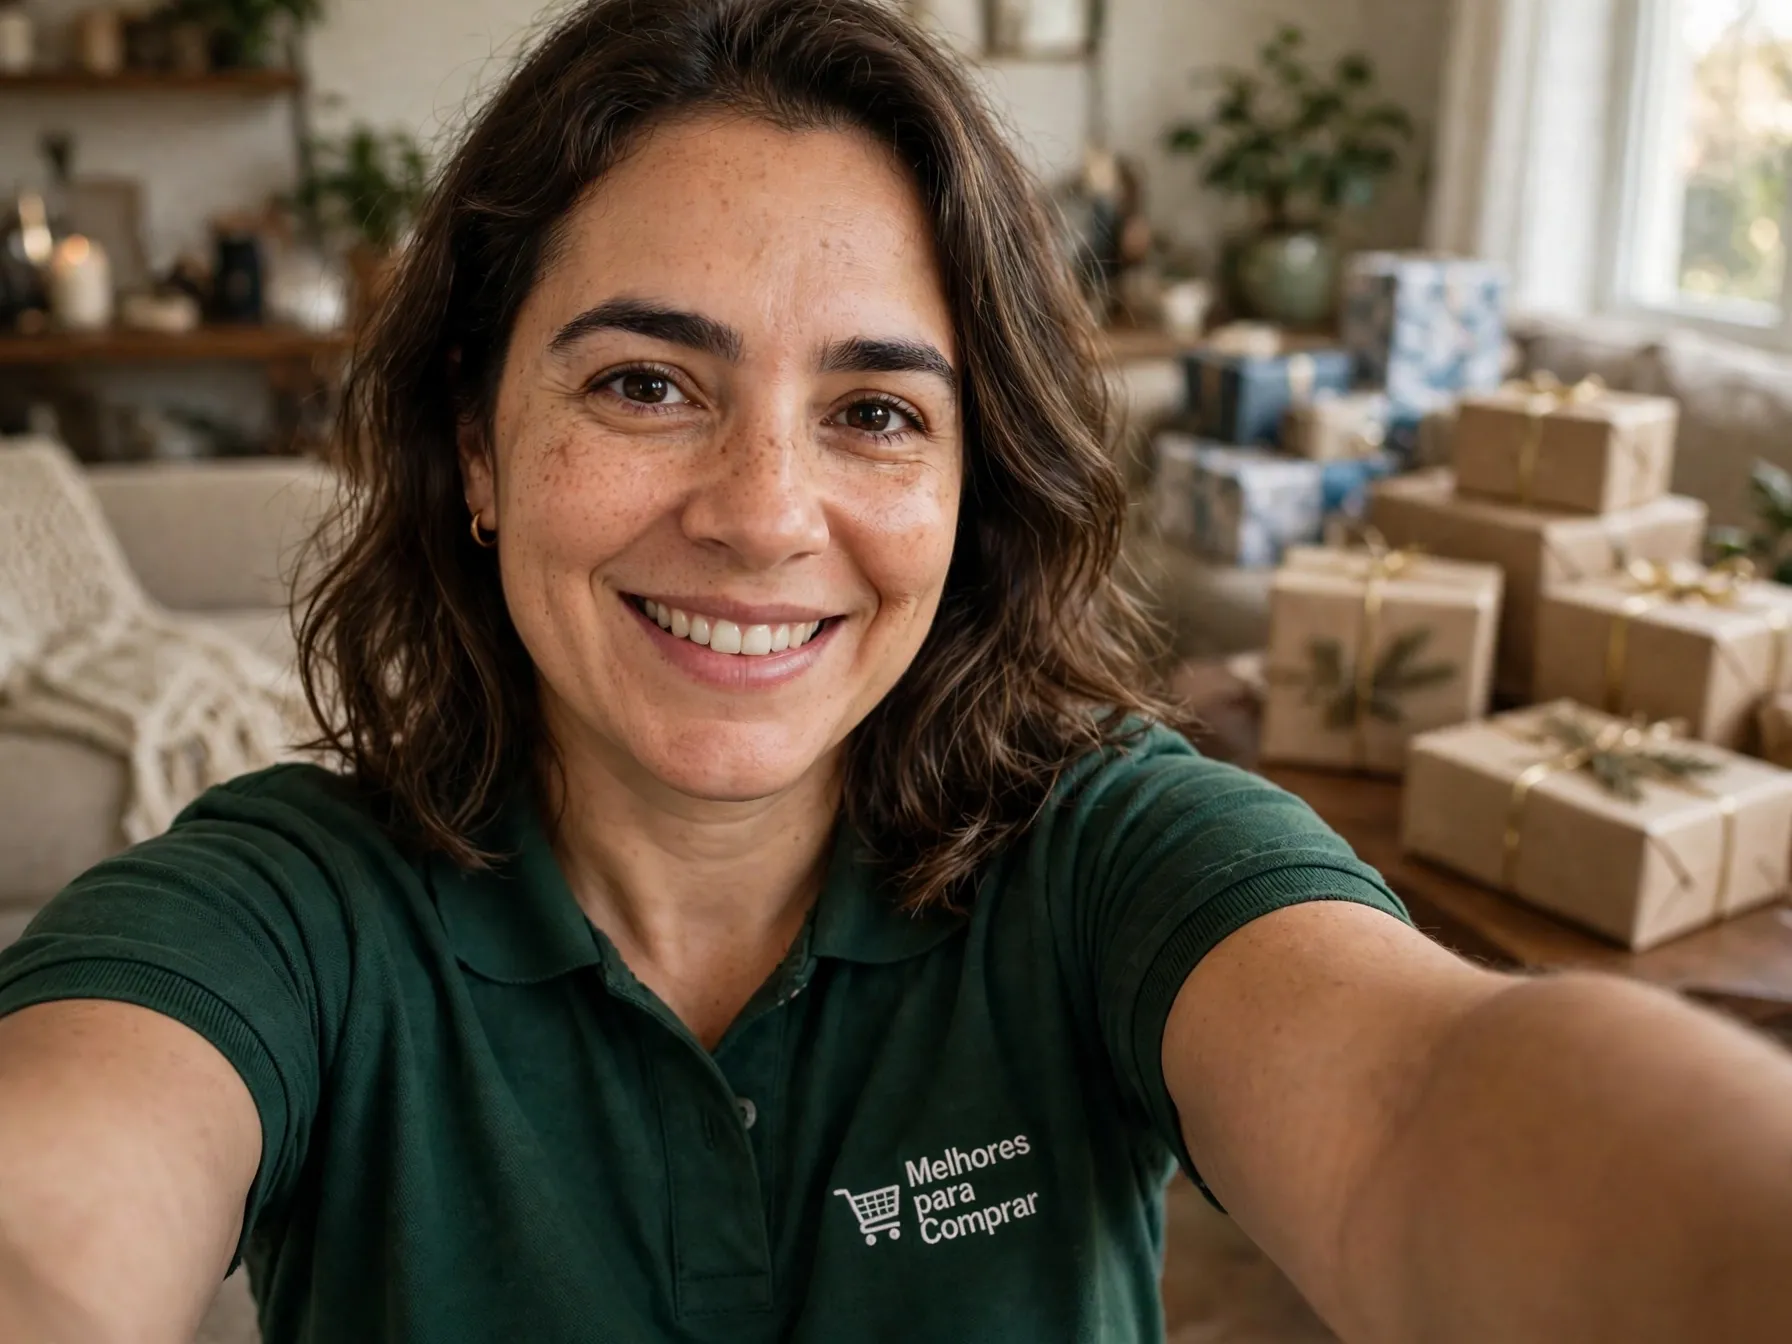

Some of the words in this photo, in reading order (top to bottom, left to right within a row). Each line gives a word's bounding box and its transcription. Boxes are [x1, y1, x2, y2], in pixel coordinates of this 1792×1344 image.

[905, 1134, 1031, 1187] Melhores
[913, 1182, 976, 1222] para
[920, 1192, 1038, 1244] Comprar
